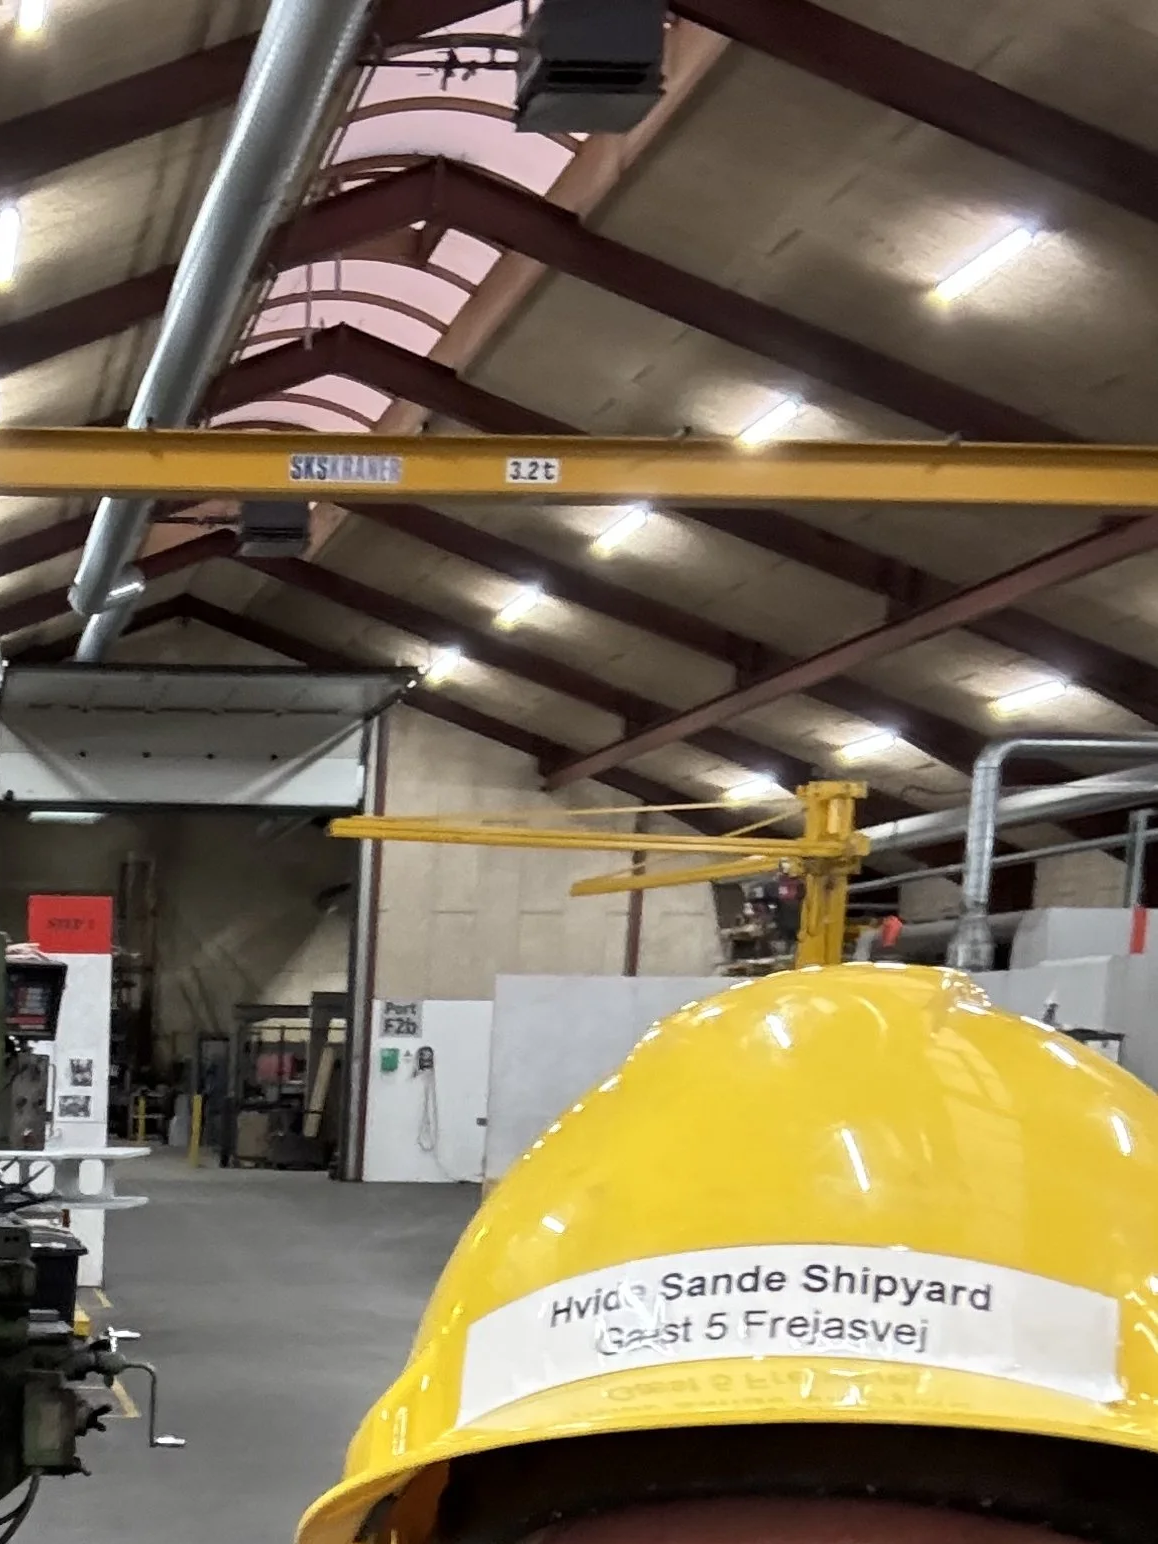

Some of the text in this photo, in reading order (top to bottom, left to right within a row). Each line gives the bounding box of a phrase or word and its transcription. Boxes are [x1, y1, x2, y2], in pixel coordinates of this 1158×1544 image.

[385, 1002, 417, 1016] Port
[661, 1265, 786, 1300] Sande
[802, 1264, 992, 1312] Shipyard
[705, 1312, 727, 1340] 5
[743, 1309, 929, 1352] Frejasvej
